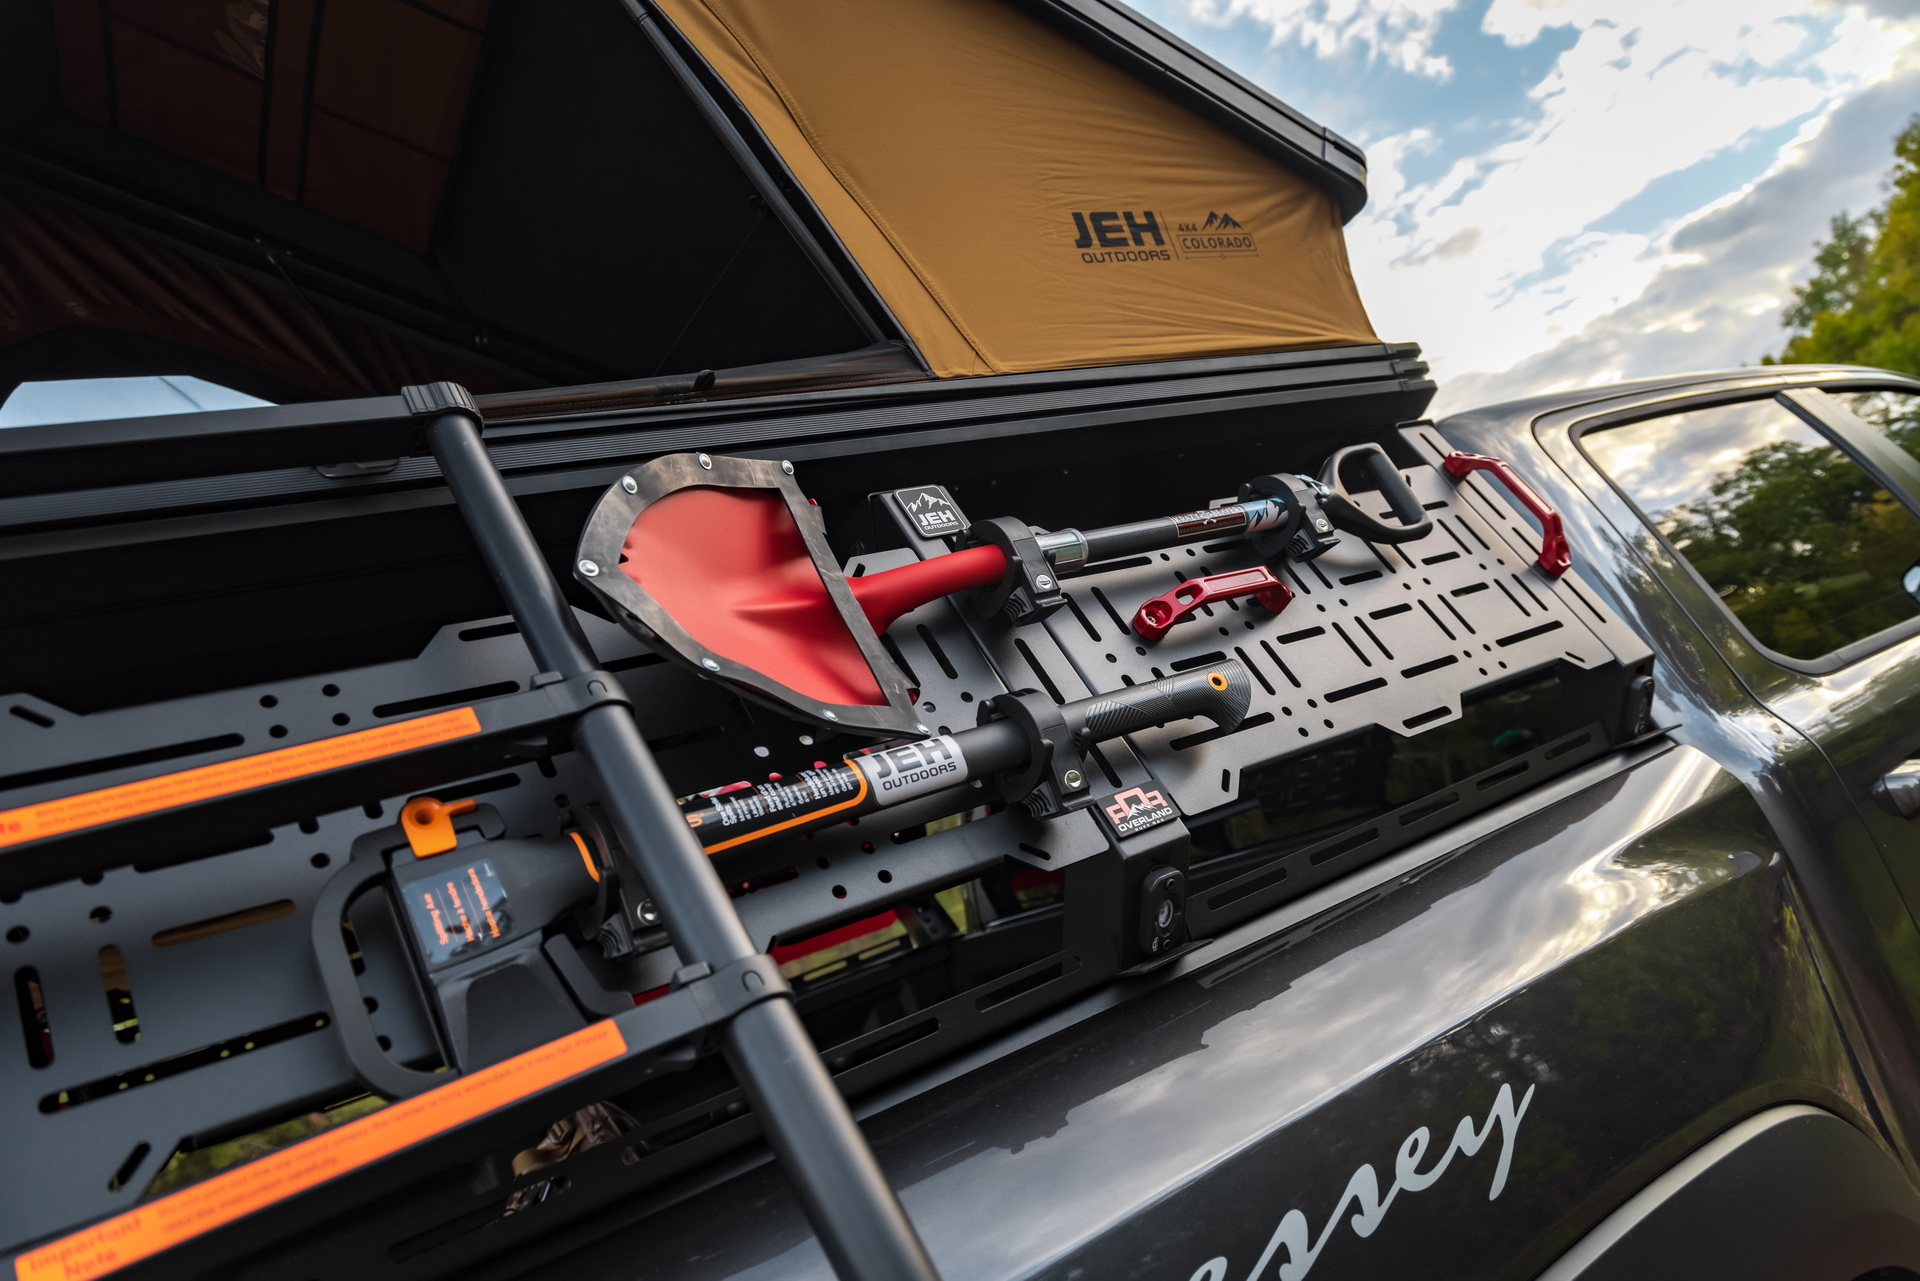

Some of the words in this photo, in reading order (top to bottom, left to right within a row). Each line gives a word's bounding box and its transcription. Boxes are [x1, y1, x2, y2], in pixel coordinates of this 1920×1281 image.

[1071, 210, 1166, 249] JEH
[1178, 223, 1198, 233] 4X4
[1182, 237, 1253, 250] COLORADO
[1081, 250, 1171, 264] OUTDOORS
[918, 510, 956, 526] JEH
[1172, 511, 1201, 524] KRAZY
[1209, 505, 1243, 518] BEAVER
[923, 521, 959, 530] OUTDOORS
[873, 739, 953, 779] JEH
[882, 761, 957, 791] OUTDOORS
[764, 795, 777, 811] Fend
[720, 810, 730, 826] One
[1118, 807, 1172, 832] OVERLAND
[424, 893, 435, 909] Axe
[430, 909, 449, 945] Splitting
